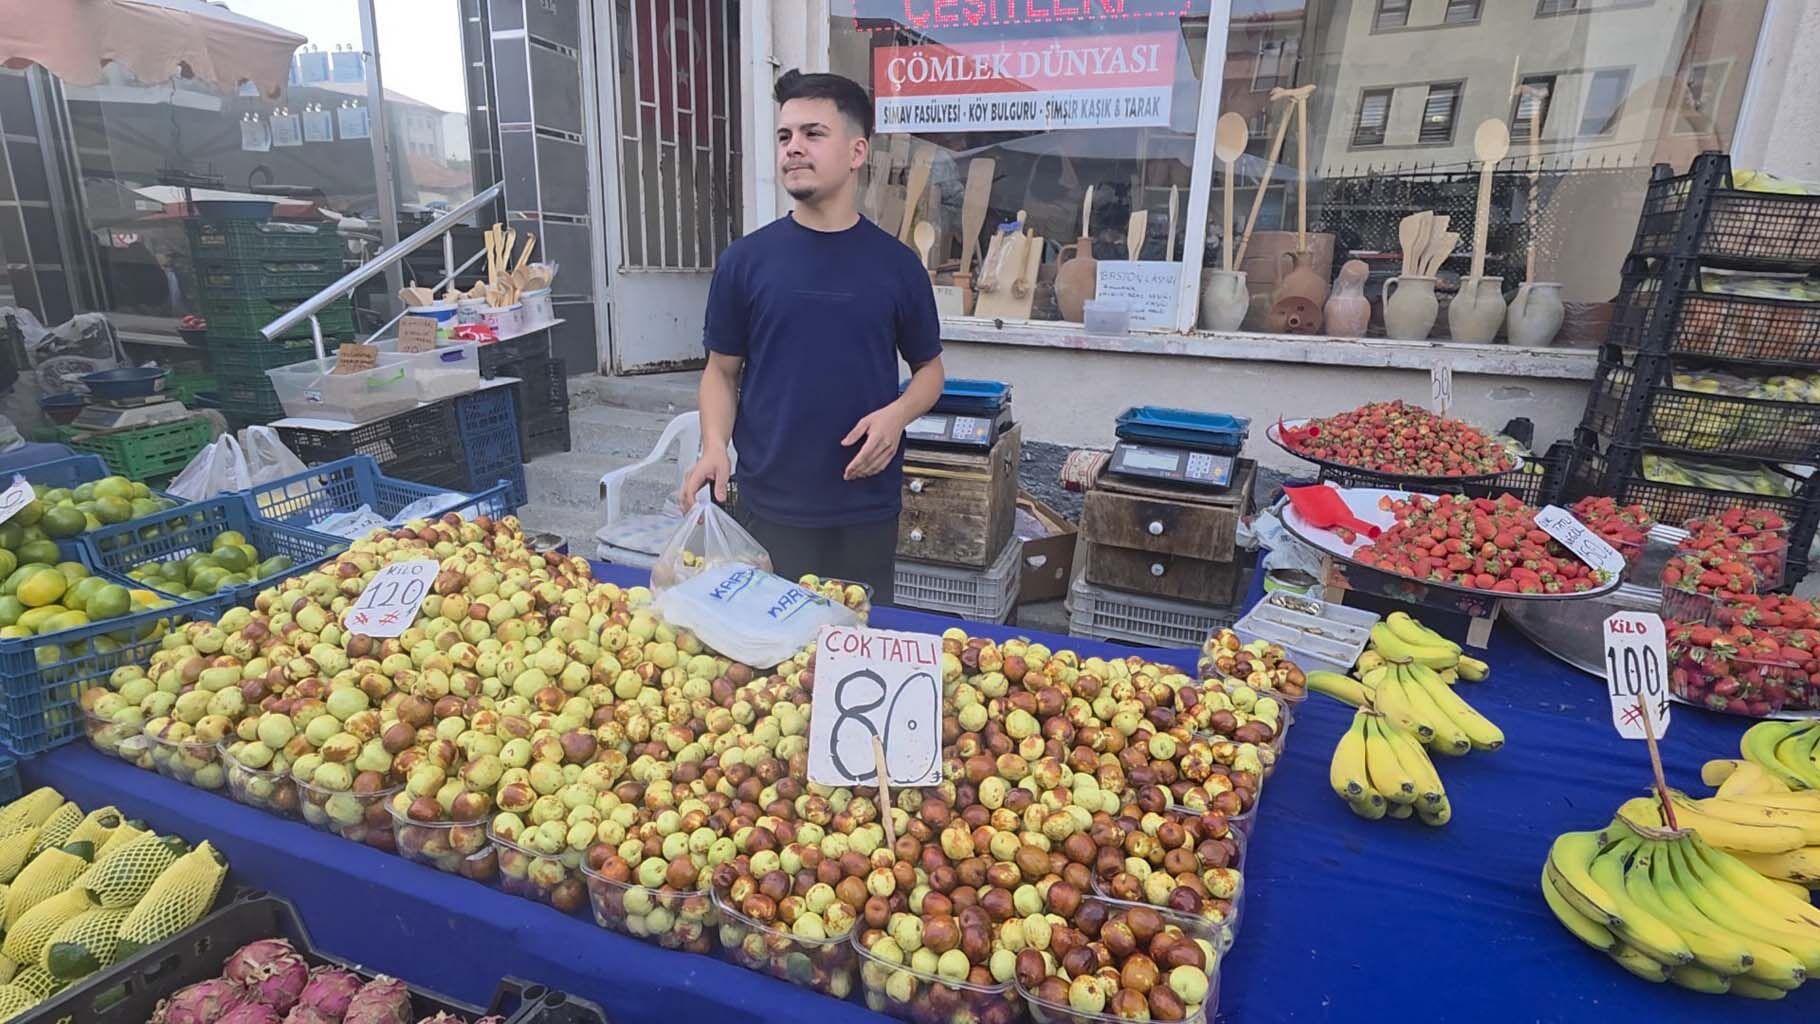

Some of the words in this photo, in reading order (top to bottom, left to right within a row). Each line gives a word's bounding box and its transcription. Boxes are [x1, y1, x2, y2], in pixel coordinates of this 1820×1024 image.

[887, 51, 1014, 91] ÇÖMLEK
[1018, 42, 1161, 78] DÜNYASI
[914, 99, 961, 123] FASÜLYESİ
[968, 97, 988, 121] KÖY
[991, 99, 1036, 122] BULGURU
[1124, 97, 1160, 119] TARAK
[358, 578, 424, 610] 120
[877, 636, 937, 665] TATLI
[1607, 644, 1660, 697] 100
[830, 668, 938, 784] 80
